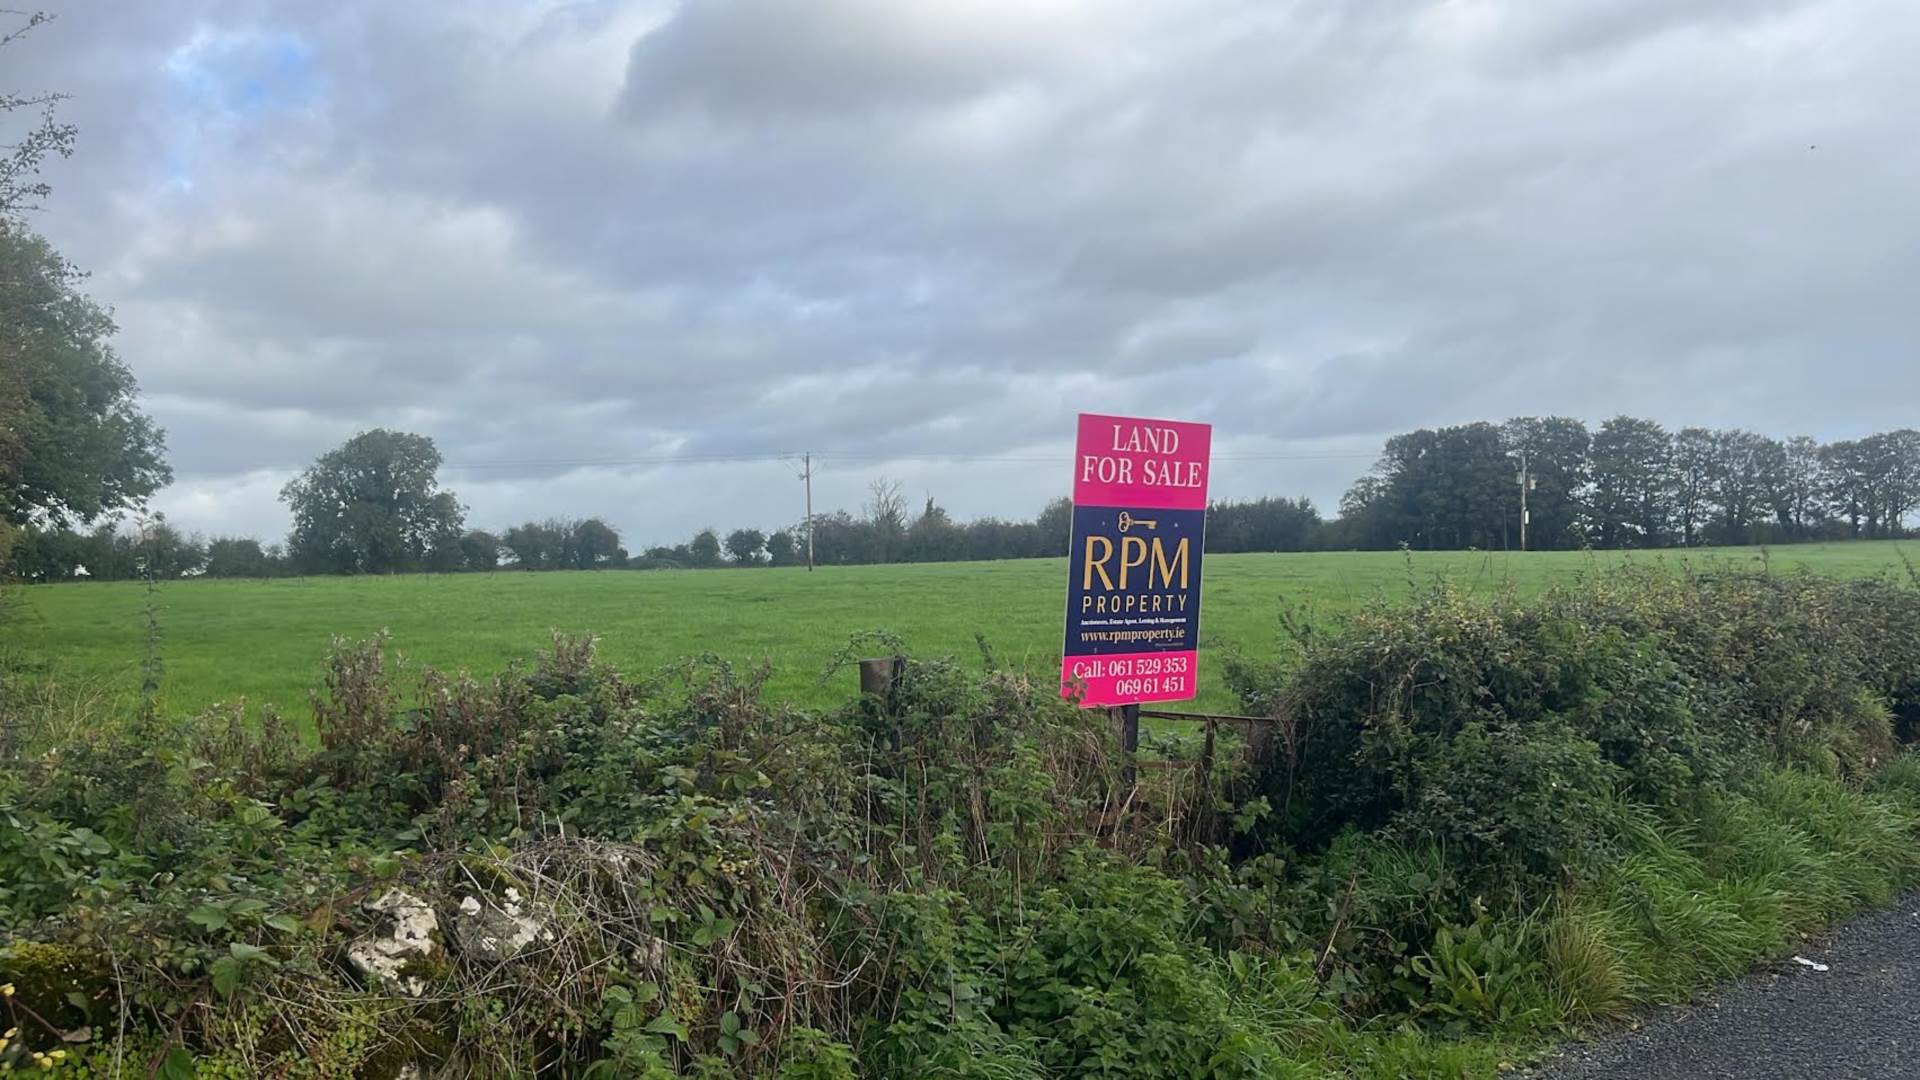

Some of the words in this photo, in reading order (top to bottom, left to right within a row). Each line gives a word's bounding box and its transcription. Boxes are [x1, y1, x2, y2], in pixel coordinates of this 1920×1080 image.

[1112, 424, 1179, 454] LAND
[1082, 455, 1133, 484] FOR
[1143, 459, 1202, 488] SALE
[1083, 536, 1189, 591] RPM
[1082, 594, 1187, 614] PROPERTY
[1080, 627, 1185, 643] www.rpmproperty.ie
[1073, 661, 1106, 679] Call:
[1108, 660, 1133, 677] 061
[1136, 659, 1161, 675] 529
[1163, 656, 1187, 673] 353
[1116, 679, 1141, 696] 069
[1143, 678, 1159, 694] 61
[1162, 677, 1185, 692] 451
